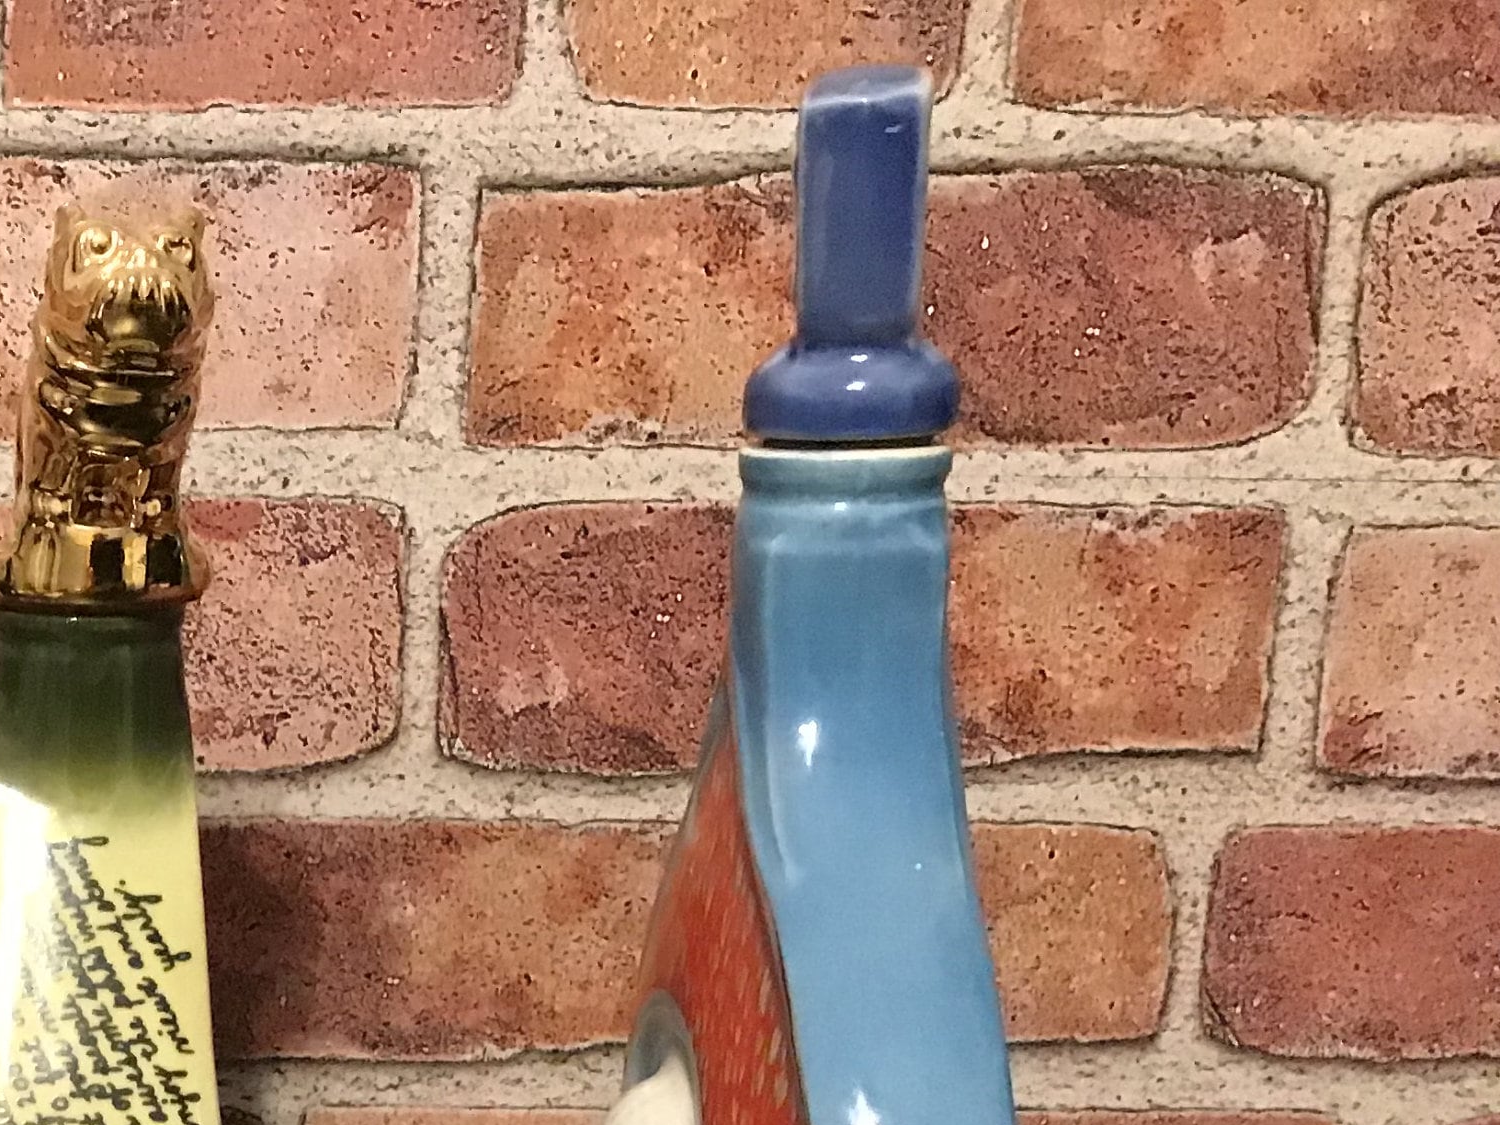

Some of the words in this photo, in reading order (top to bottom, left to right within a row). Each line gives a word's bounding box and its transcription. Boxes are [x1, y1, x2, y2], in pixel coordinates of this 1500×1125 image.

[99, 915, 144, 970] and
[114, 880, 192, 972] yearly.
[24, 1038, 66, 1085] feet
[93, 1003, 168, 1123] awesome
[129, 1016, 158, 1062] the
[95, 1082, 131, 1112] of
